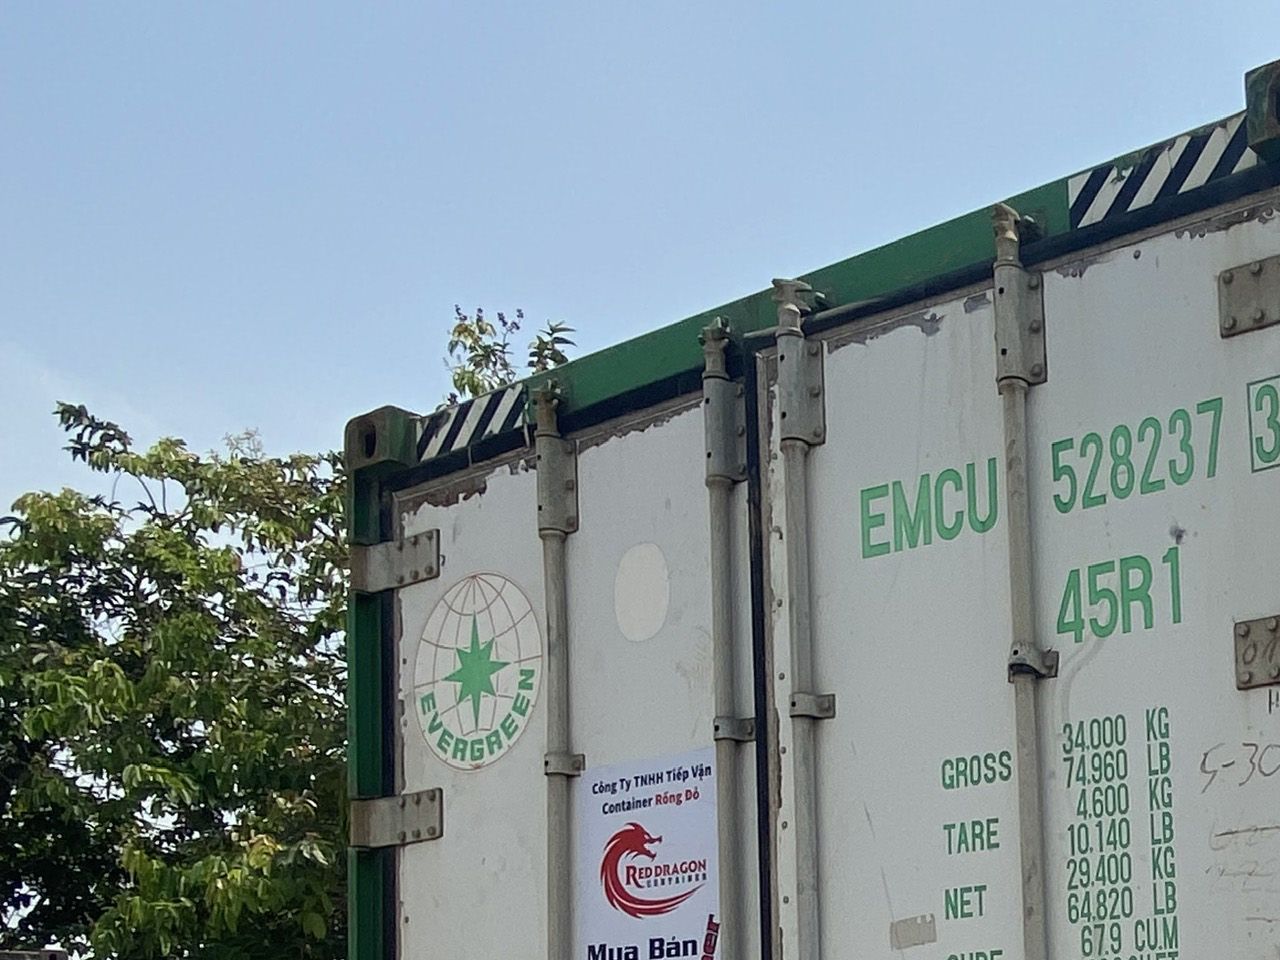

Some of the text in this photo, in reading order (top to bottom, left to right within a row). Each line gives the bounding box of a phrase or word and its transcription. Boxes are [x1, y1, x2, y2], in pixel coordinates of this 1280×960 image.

[859, 457, 999, 560] EMCU
[1050, 396, 1224, 515] 528237
[1056, 546, 1182, 644] 45R1
[420, 668, 535, 761] EVERGREEN
[1062, 706, 1170, 754] 34.000 KG
[619, 778, 632, 793] Ty
[633, 771, 664, 788] TNHH
[941, 750, 1012, 790] GROSS
[1062, 741, 1171, 789] 74.960 LB
[602, 796, 654, 815] Container
[1076, 776, 1173, 820] 4.600 KG
[943, 817, 1001, 855] TARE
[1067, 817, 1131, 857] 10.140
[1150, 811, 1174, 846] LB
[646, 872, 708, 889] CONTAINER
[1066, 852, 1132, 891] 29.400
[1151, 846, 1176, 881] KG
[944, 884, 988, 921] NET
[1067, 880, 1177, 924] 64.820 LB
[648, 935, 698, 960] Bán
[1080, 916, 1179, 958] 67.9 CU.M
